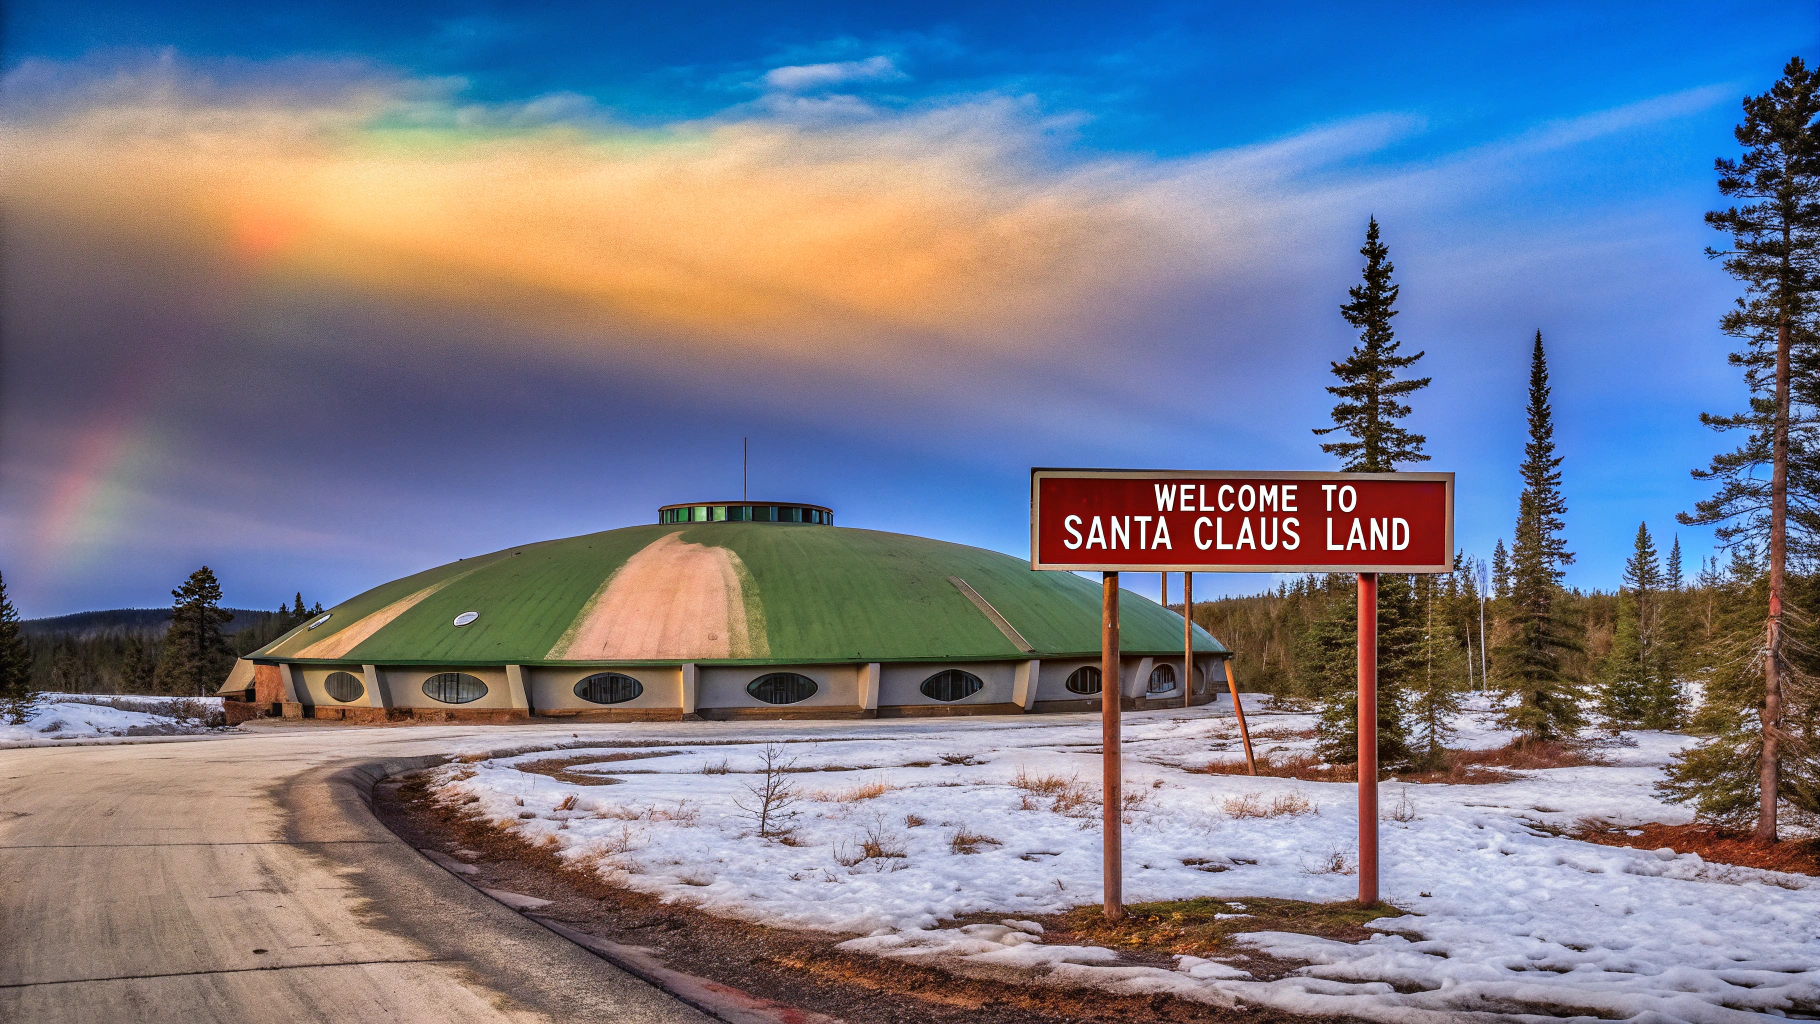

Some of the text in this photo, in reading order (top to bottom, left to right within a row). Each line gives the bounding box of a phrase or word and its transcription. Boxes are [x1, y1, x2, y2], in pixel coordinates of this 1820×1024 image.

[1154, 484, 1357, 512] WELCOME TO
[1063, 515, 1410, 551] SANTA CLAUS LAND
